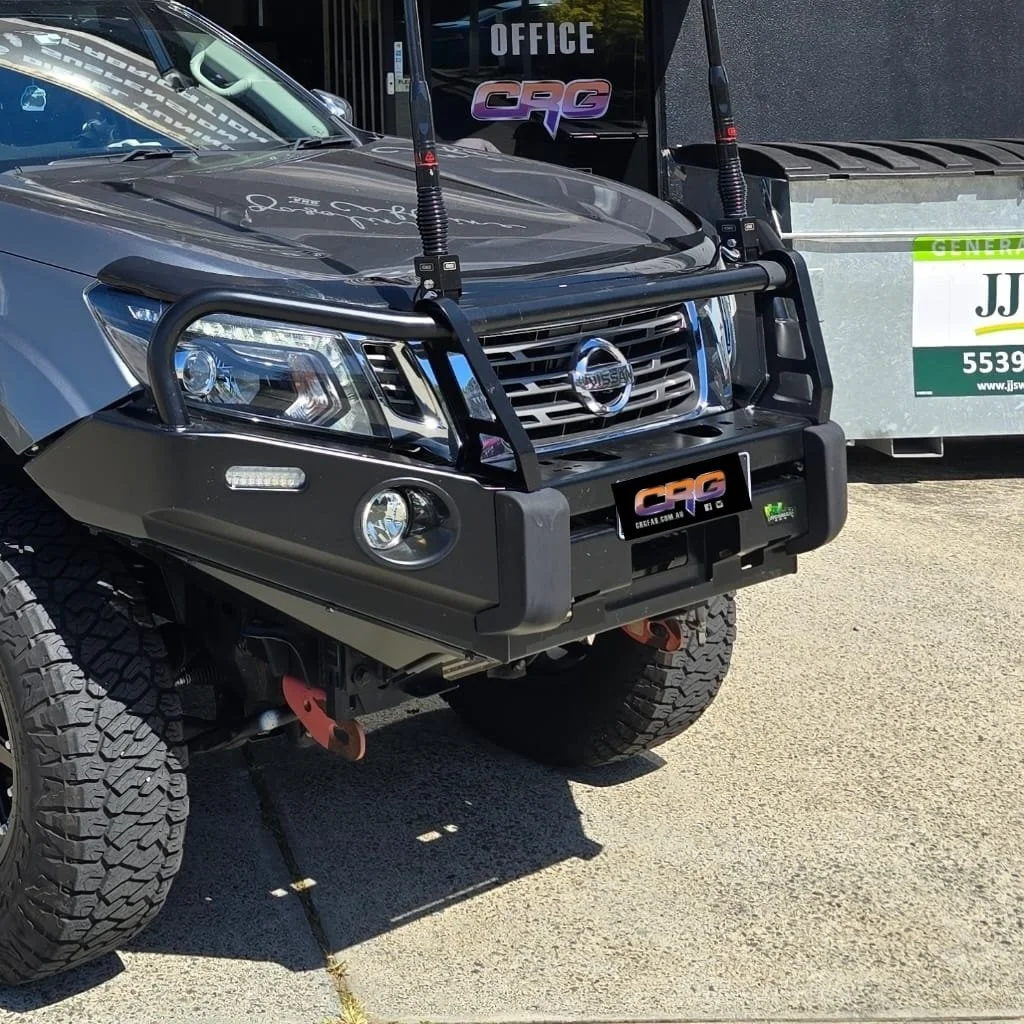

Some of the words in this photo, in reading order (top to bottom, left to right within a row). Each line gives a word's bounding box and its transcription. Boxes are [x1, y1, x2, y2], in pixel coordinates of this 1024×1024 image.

[490, 21, 595, 56] OFFICE
[471, 78, 613, 141] CRG
[975, 272, 1024, 318] JJ
[583, 363, 633, 388] NISSAN
[962, 350, 1024, 374] 5539
[634, 469, 726, 517] CRG
